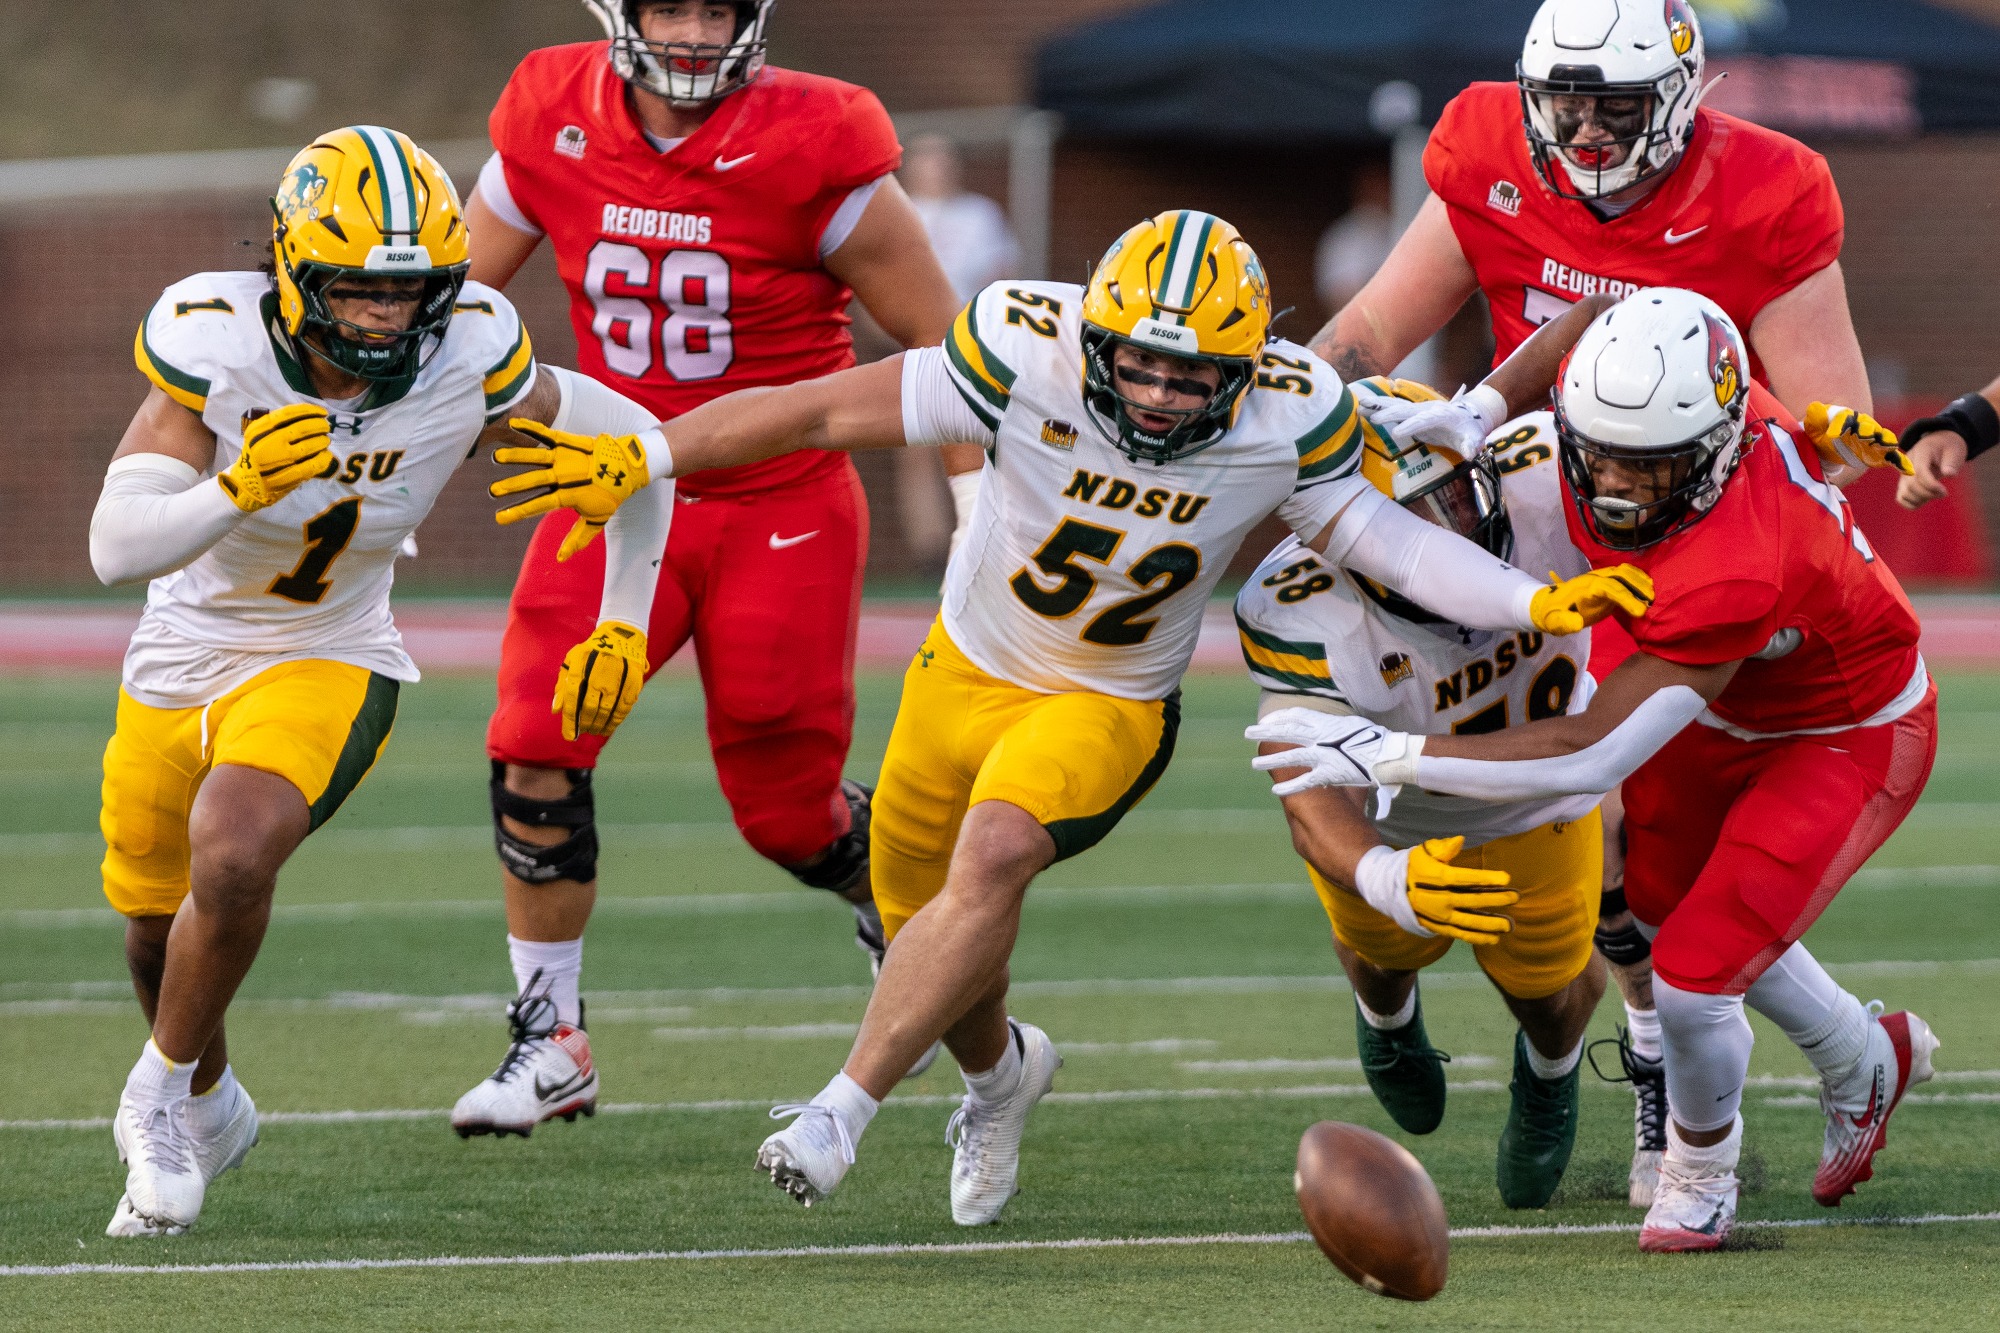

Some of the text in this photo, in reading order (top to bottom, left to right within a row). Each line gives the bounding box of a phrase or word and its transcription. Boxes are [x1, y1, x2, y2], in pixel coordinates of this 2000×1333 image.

[1488, 185, 1522, 212] VALLEY
[601, 203, 713, 244] REDBIRDS
[385, 252, 416, 262] BISON
[1542, 257, 1651, 301] REDBIRD
[174, 297, 235, 318] 1
[425, 283, 453, 315] Ridde
[583, 239, 734, 382] 68
[1005, 288, 1063, 339] 52
[1149, 326, 1182, 342] BISON
[1255, 352, 1315, 398] 52
[1041, 422, 1078, 447] VALLEY
[1133, 430, 1165, 446] Riddell
[1484, 424, 1553, 478] 58
[1407, 458, 1433, 479] BISON
[1061, 468, 1212, 525] NDSU
[265, 495, 365, 605] 1
[1008, 514, 1203, 648] 52
[1261, 555, 1336, 605] 58
[1434, 630, 1544, 714] NDSU
[1451, 653, 1578, 736] 8
